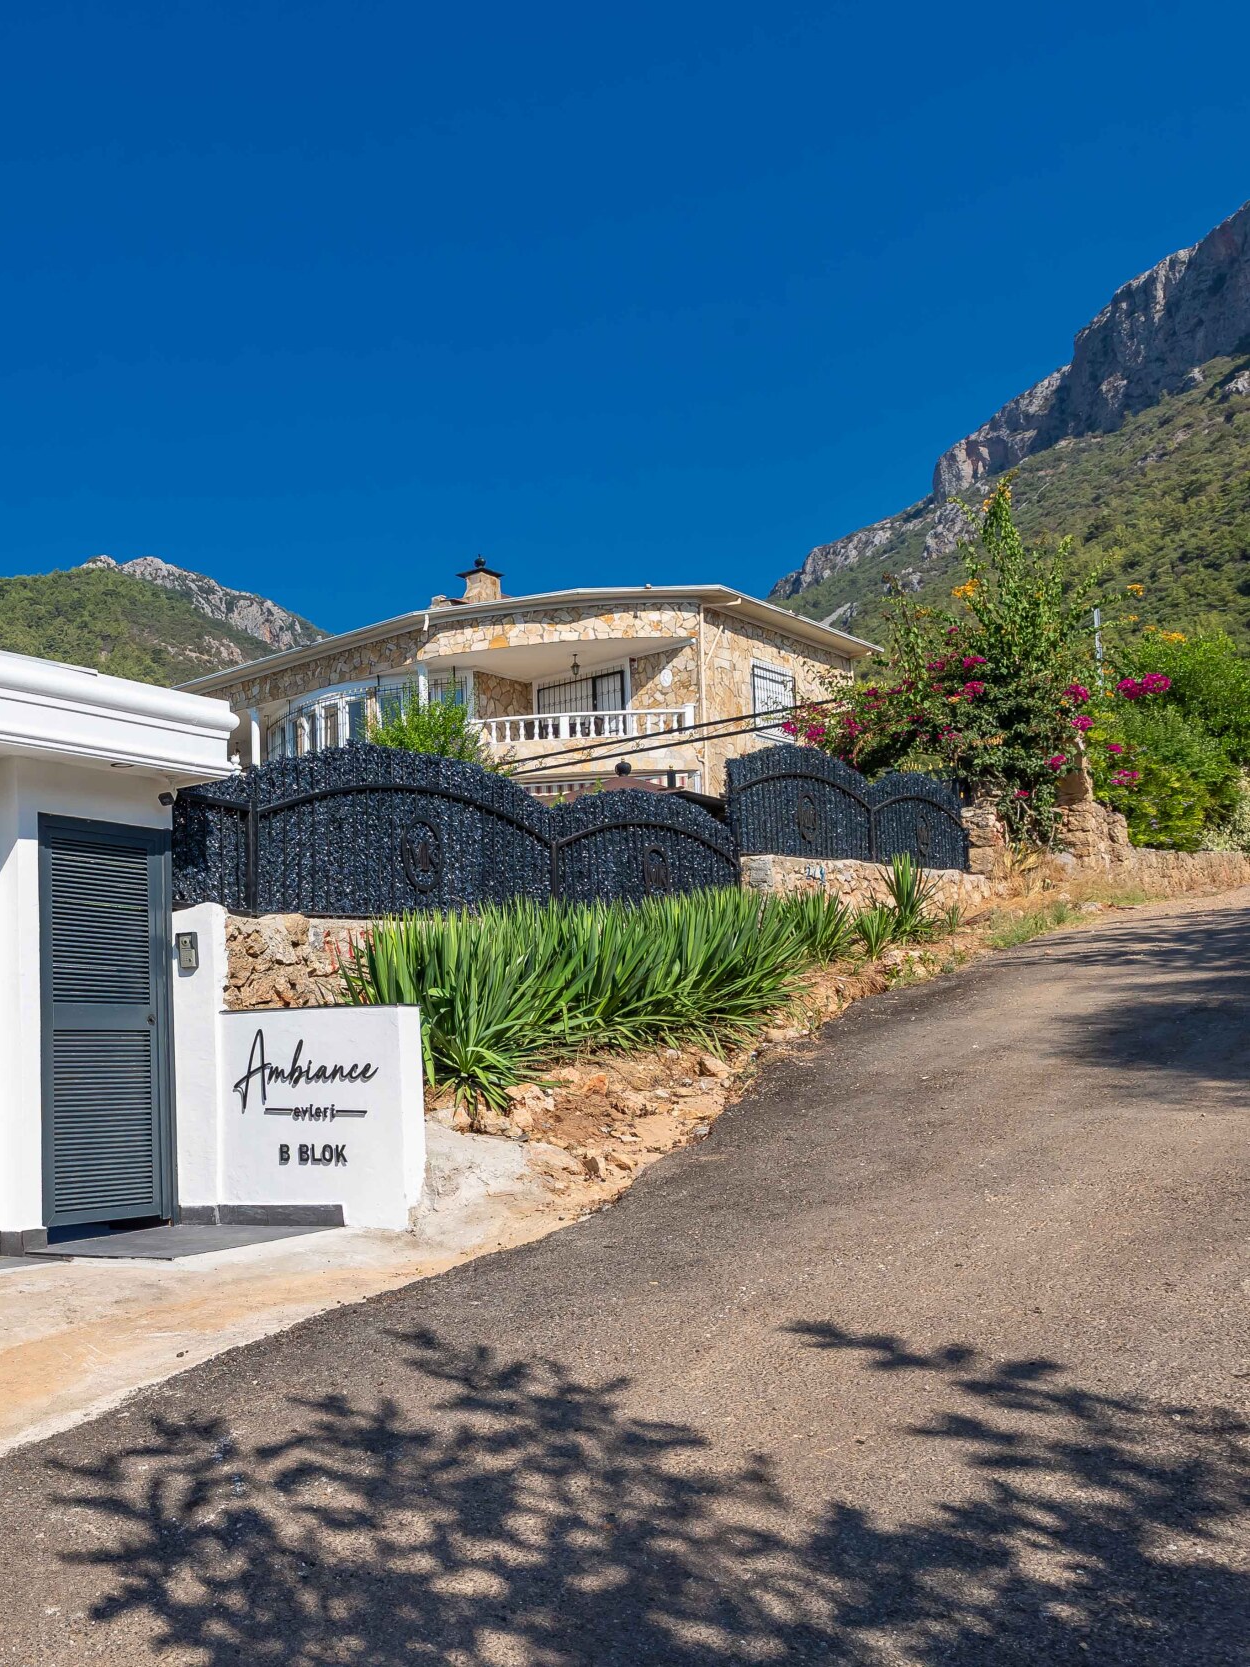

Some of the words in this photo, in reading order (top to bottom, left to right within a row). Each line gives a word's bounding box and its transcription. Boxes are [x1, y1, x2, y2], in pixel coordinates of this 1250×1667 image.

[233, 1029, 379, 1112] Ambiance
[293, 1104, 336, 1120] evleri
[279, 1143, 291, 1164] B
[298, 1143, 348, 1165] BLOK
